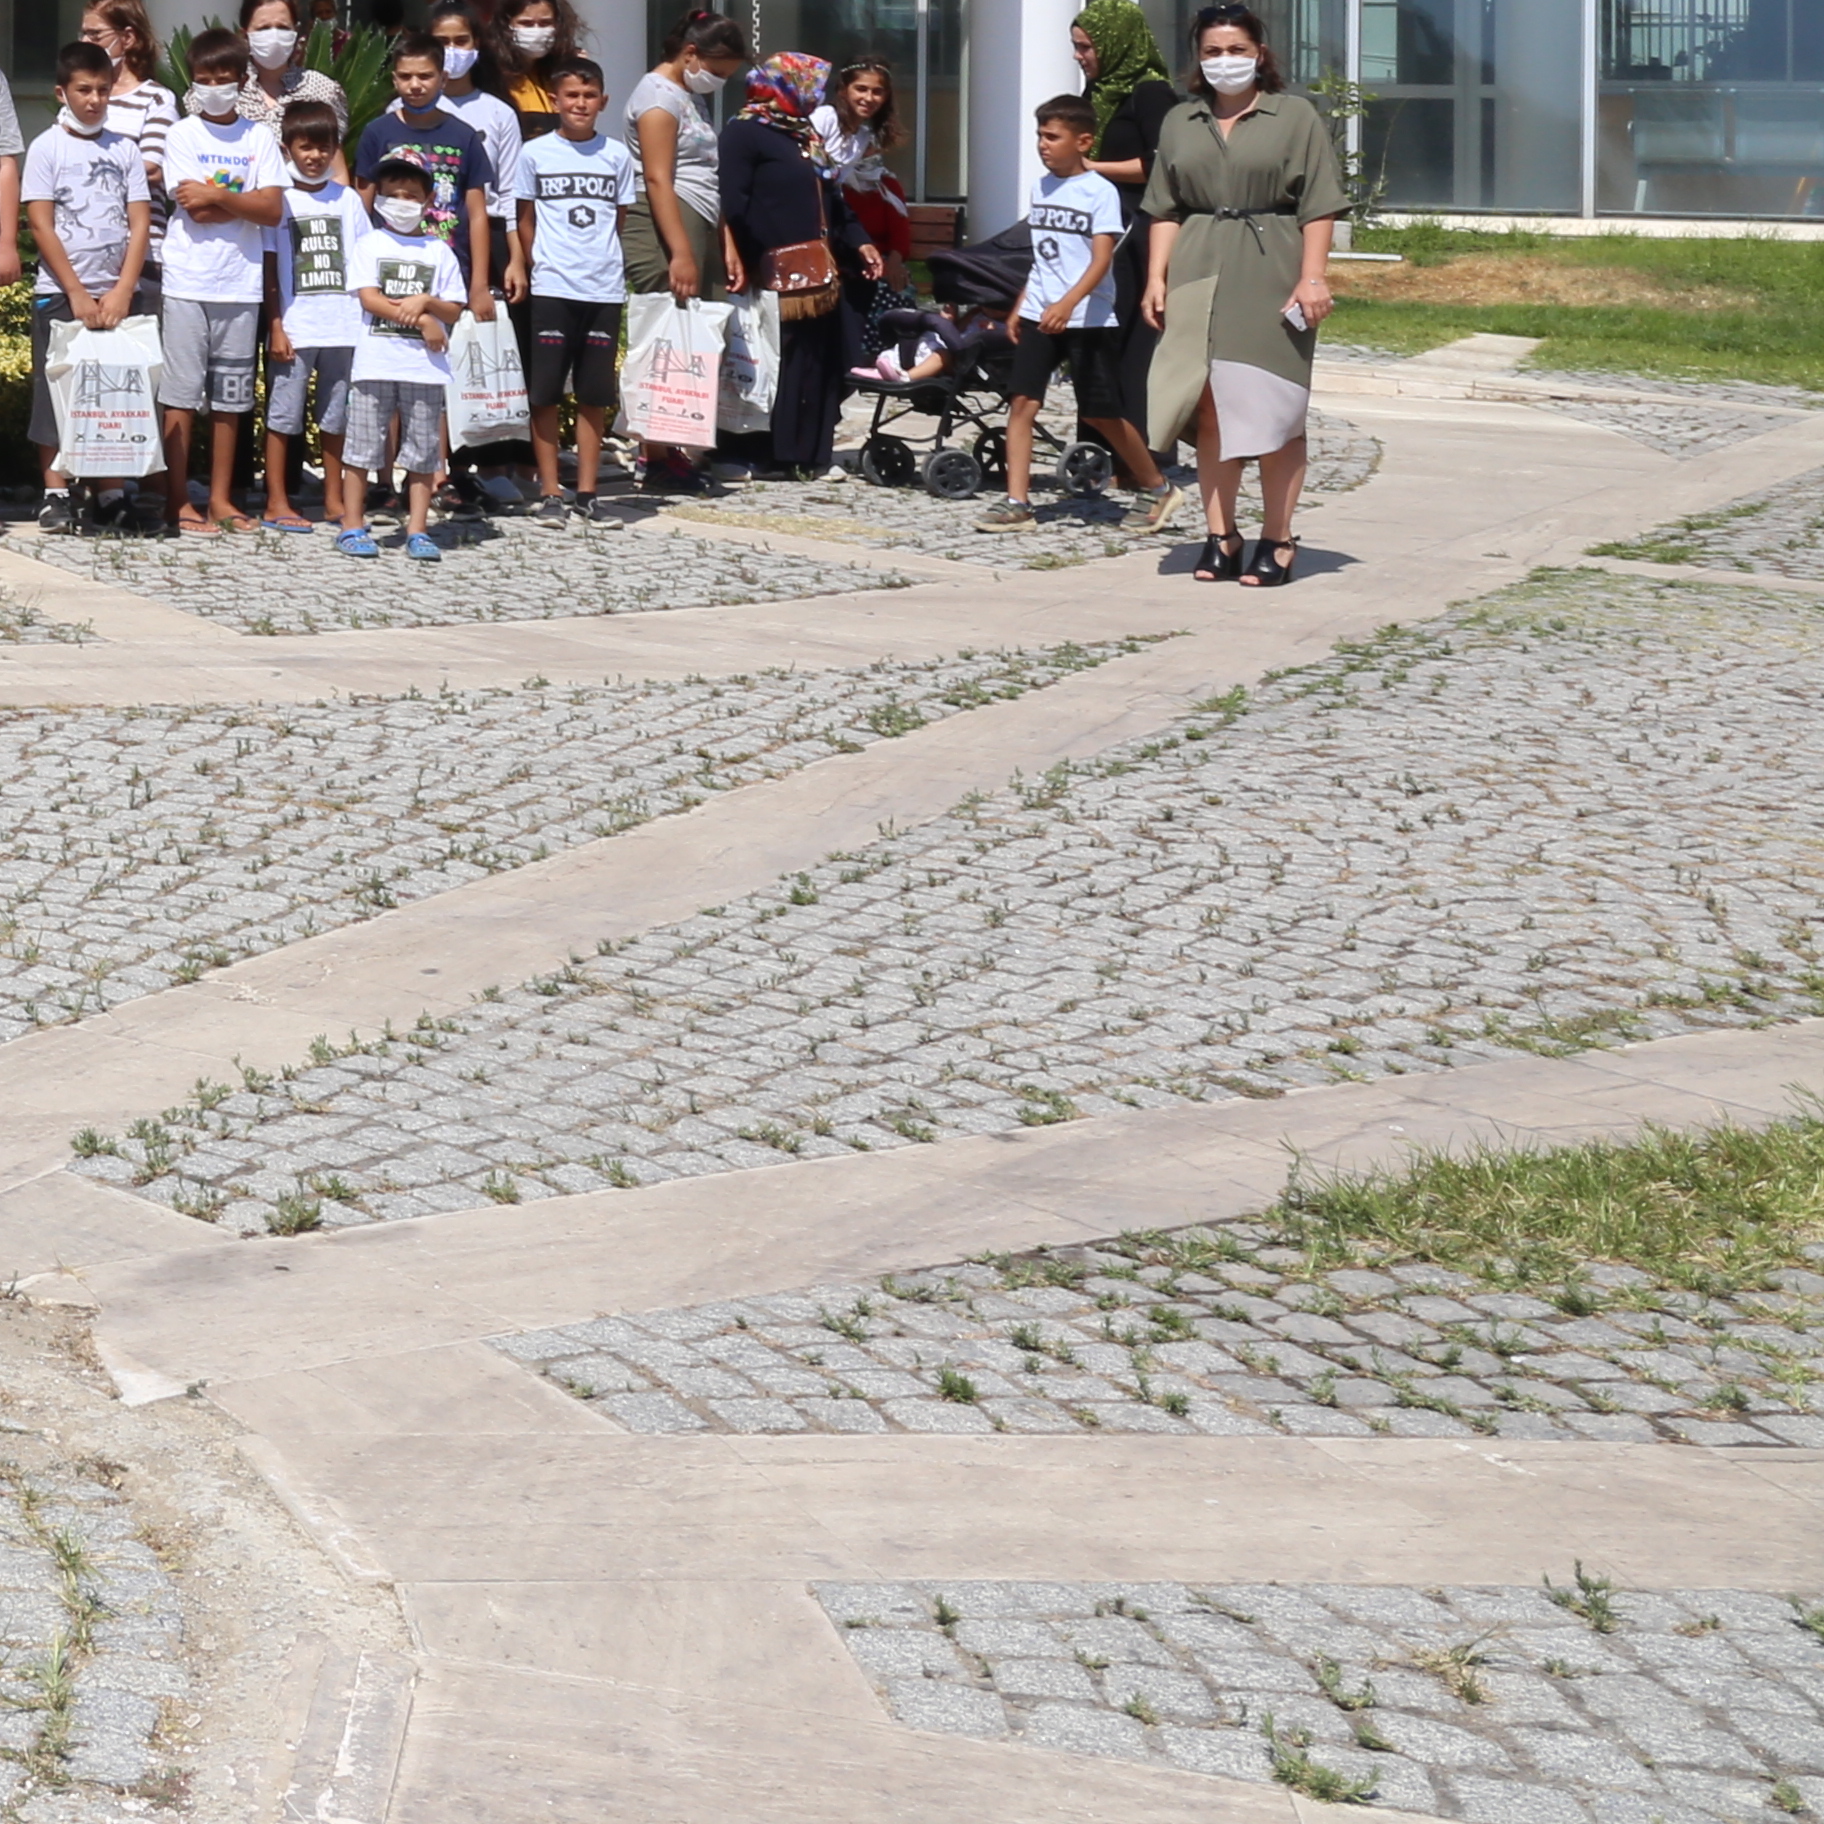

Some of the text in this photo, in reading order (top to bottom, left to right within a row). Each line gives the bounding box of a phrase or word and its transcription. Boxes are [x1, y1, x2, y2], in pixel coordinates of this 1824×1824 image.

[572, 176, 615, 198] POLO
[310, 219, 327, 235] NO
[301, 236, 339, 252] RULES
[313, 253, 331, 269] NO
[301, 270, 343, 288] LIMITS
[397, 264, 417, 279] NO
[461, 391, 494, 401] İSTANBUL
[70, 409, 150, 419] İSTANBUL AYAKKABI
[97, 422, 122, 430] FUARI
